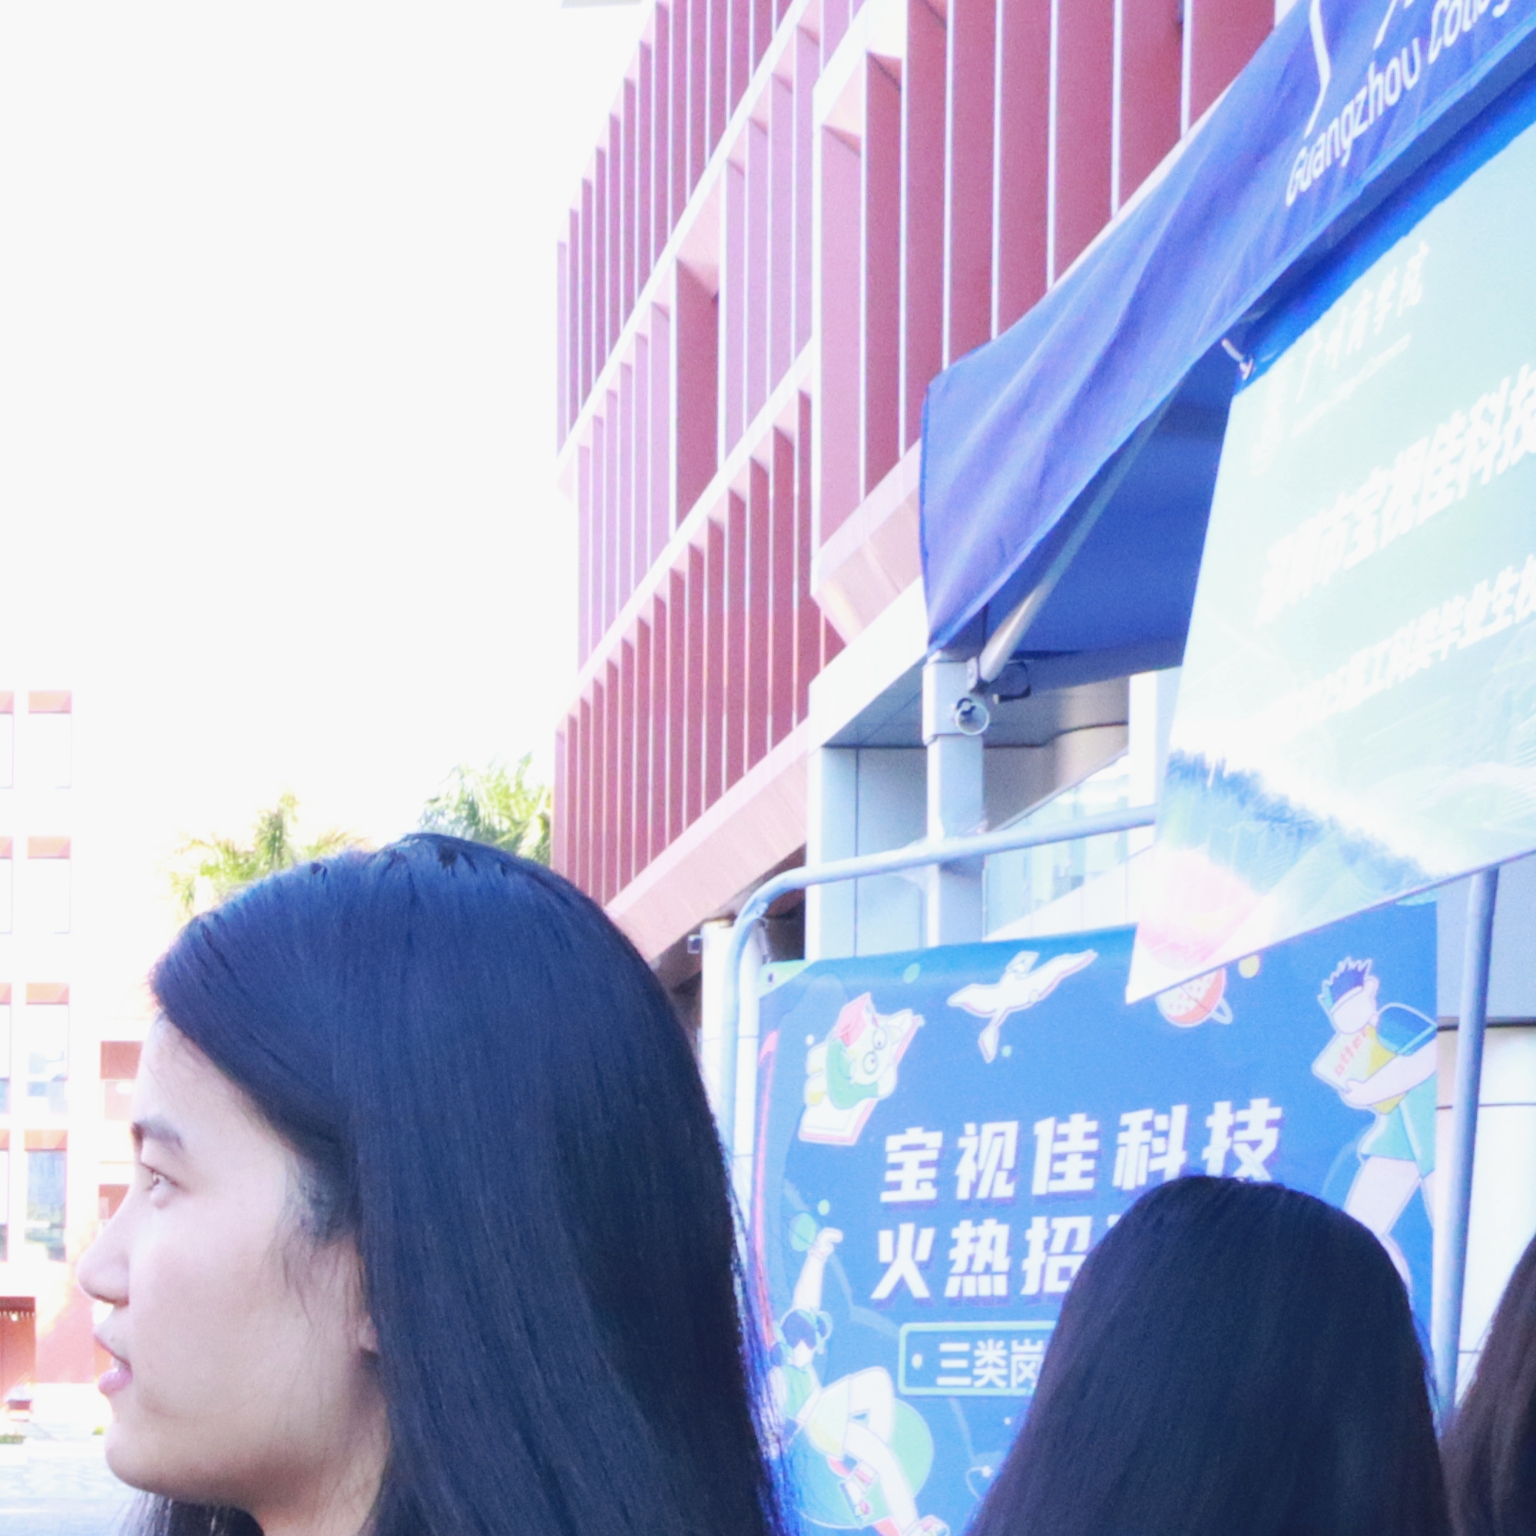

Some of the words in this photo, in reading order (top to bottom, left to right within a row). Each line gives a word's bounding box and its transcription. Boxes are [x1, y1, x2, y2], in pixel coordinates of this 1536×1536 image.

[1285, 37, 1422, 207] Guangzhou
[879, 1097, 1284, 1204] 宝视佳科技
[870, 1213, 1128, 1300] 火热招
